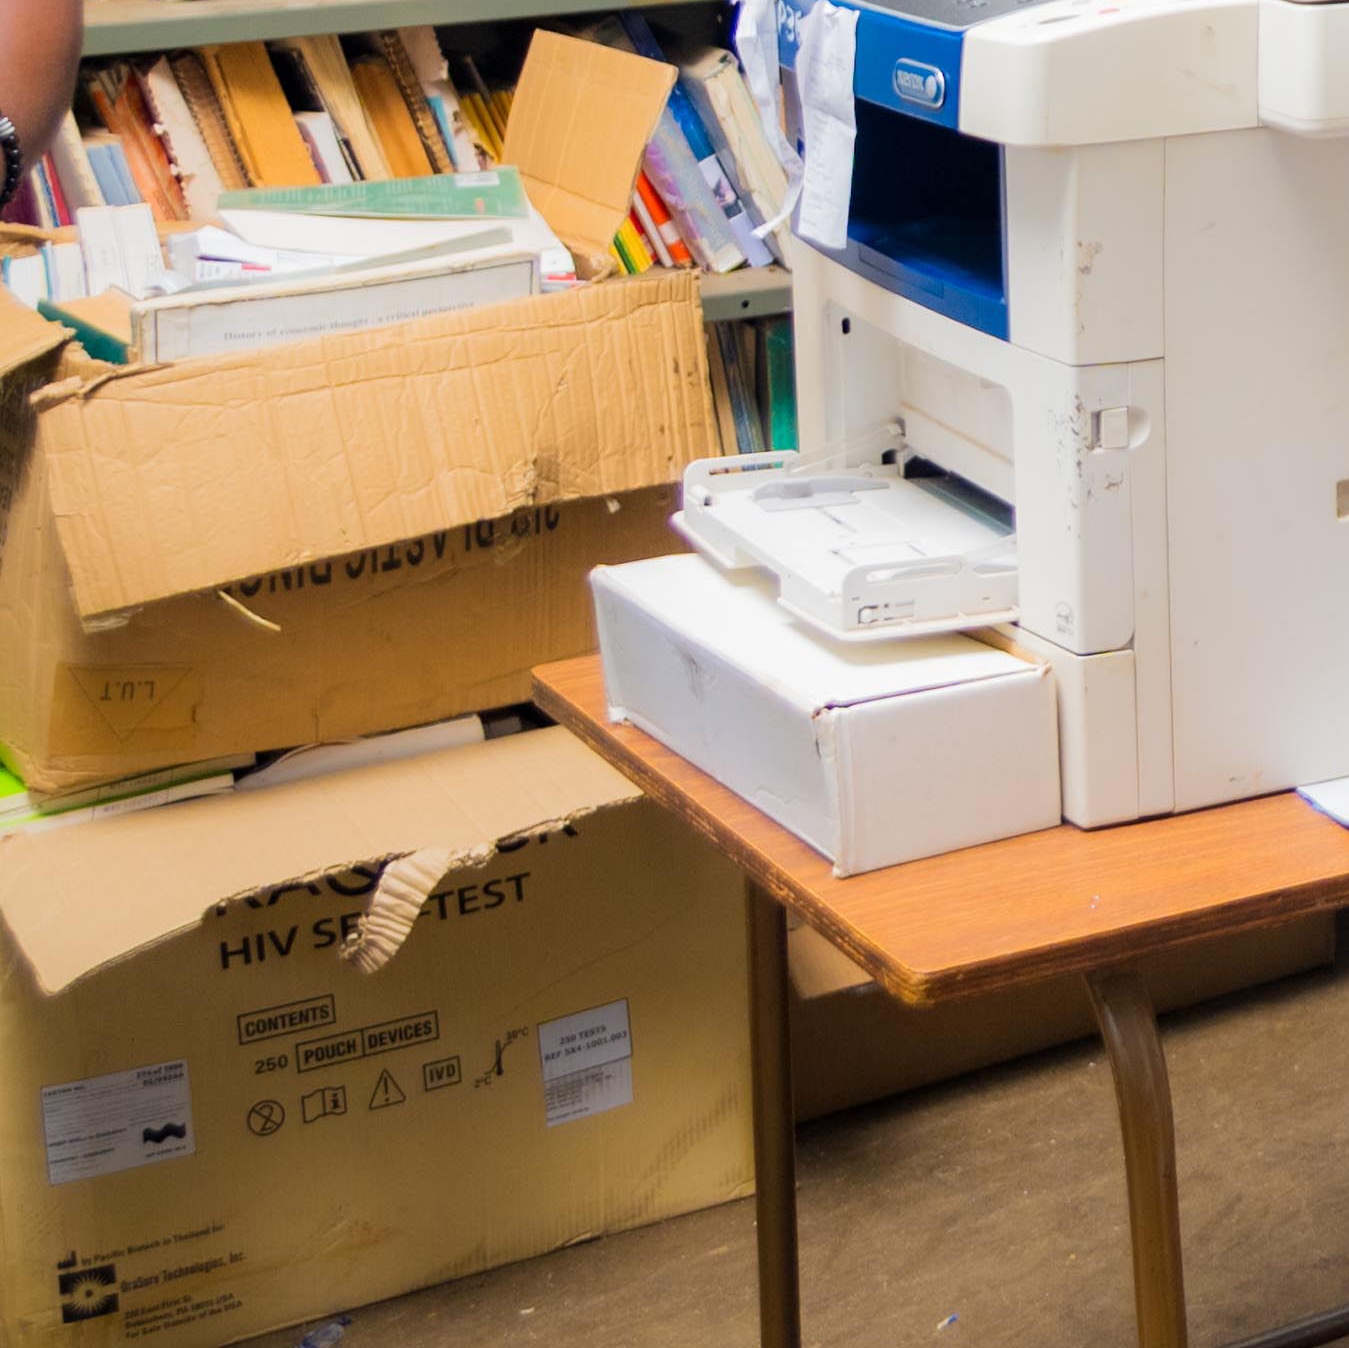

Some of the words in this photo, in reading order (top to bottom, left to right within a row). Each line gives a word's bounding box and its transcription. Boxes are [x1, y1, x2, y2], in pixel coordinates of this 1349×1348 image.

[896, 68, 925, 93] xerox
[99, 680, 154, 700] L.U.T
[219, 925, 299, 970] HIV
[313, 872, 531, 950] SE-TEST
[244, 1004, 331, 1038] CONTENTS
[579, 1025, 607, 1039] TESTS
[254, 1054, 289, 1075] 250
[303, 1038, 357, 1065] POUCH
[367, 1020, 433, 1050] DEVICES
[429, 1063, 457, 1084] IVD
[120, 1274, 160, 1293] OraSure
